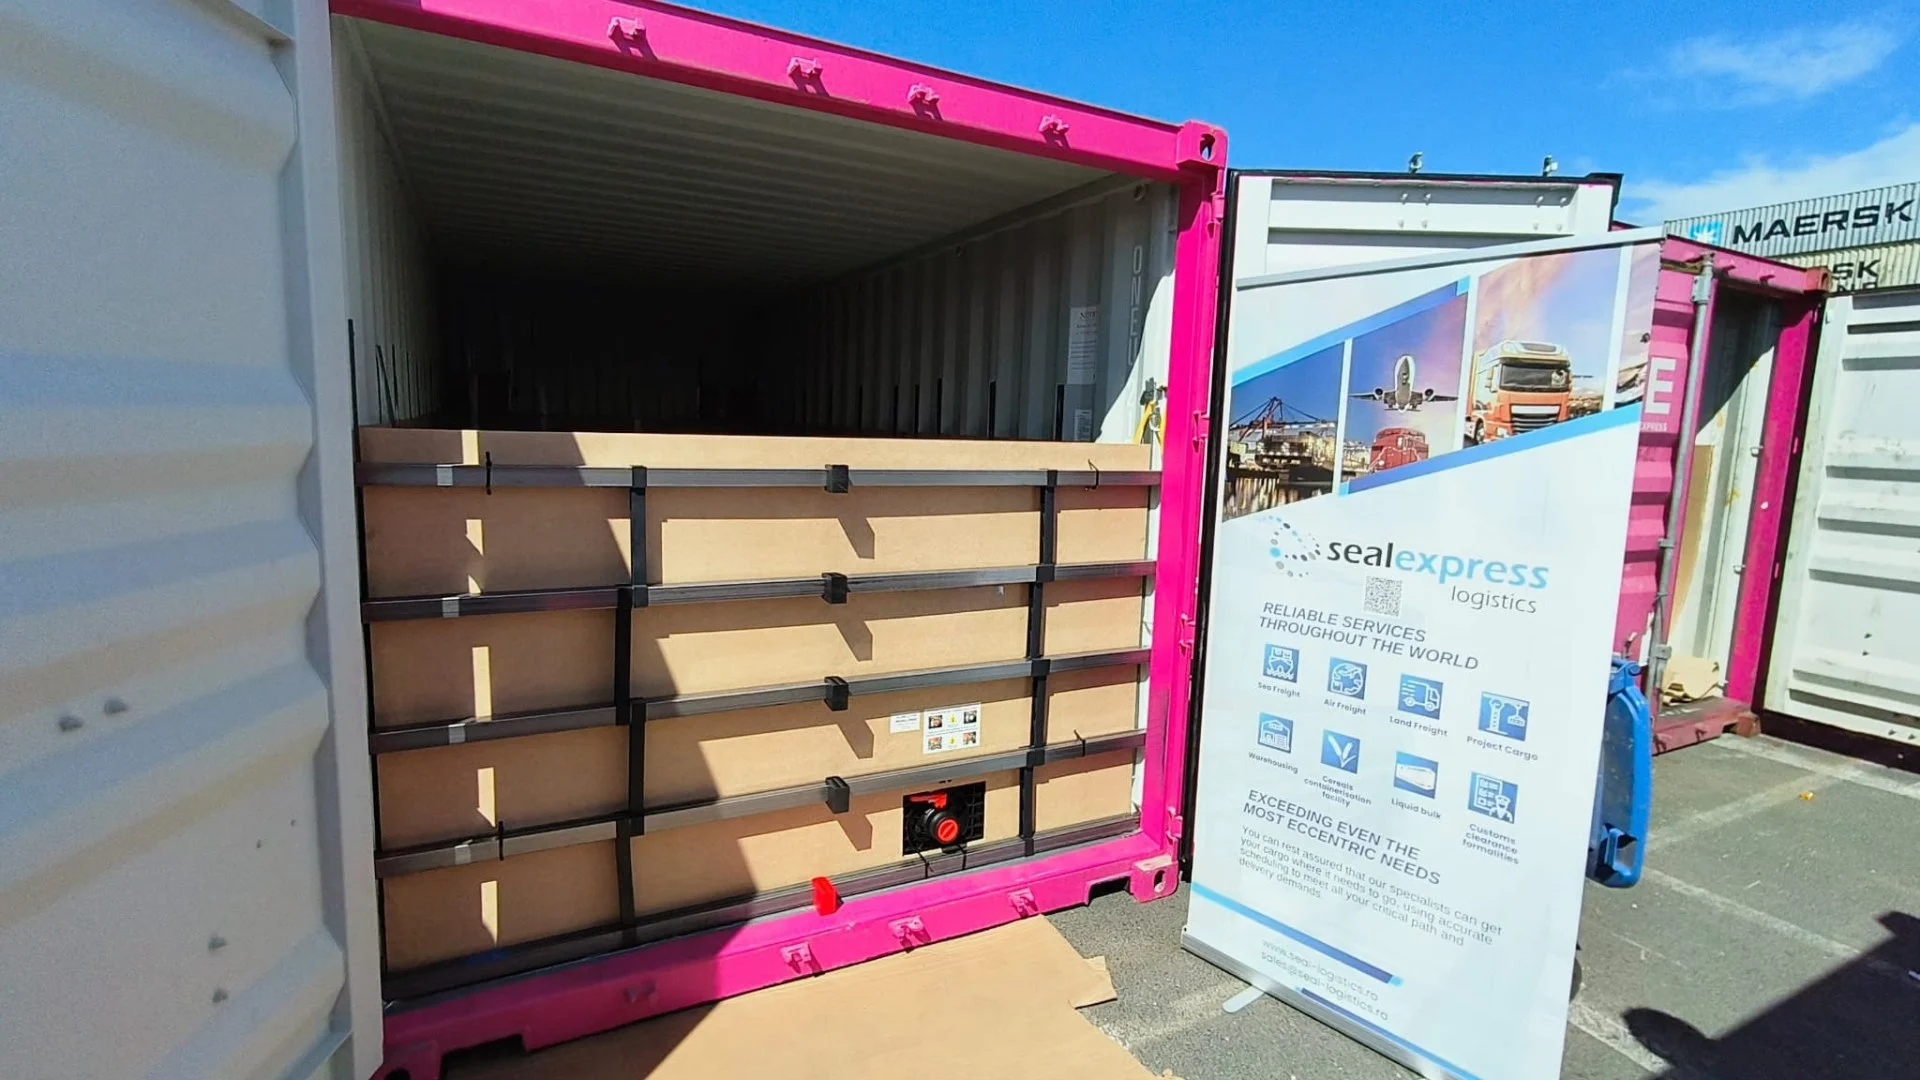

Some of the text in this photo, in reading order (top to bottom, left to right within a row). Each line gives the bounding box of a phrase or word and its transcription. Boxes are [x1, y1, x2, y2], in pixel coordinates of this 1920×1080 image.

[1732, 199, 1915, 245] MAERSK
[1450, 585, 1538, 614] logistics
[1262, 601, 1427, 643] RELIABLE SERVICES
[1259, 615, 1479, 671] THROUGHOUT THE WORLD
[1257, 681, 1301, 699] Sea Freight
[1323, 698, 1367, 716] Air Freight
[1388, 715, 1449, 738] Land Freight
[1466, 734, 1539, 762] Project Cargo
[1248, 751, 1299, 775] Warehousing
[1304, 777, 1372, 806] containerisation
[1322, 775, 1354, 792] Cereals
[1321, 790, 1351, 808] facility
[1390, 796, 1442, 819] Liquid bulk
[1248, 789, 1421, 861] EXCEEDING EVEN THE
[1468, 822, 1517, 846] Customs
[1243, 802, 1441, 886] MOST ECCENTRIC NEEDS
[1462, 838, 1520, 866] formalities
[1465, 831, 1519, 855] clearance
[1238, 857, 1275, 880] delivery
[1241, 824, 1503, 937] You can rest assured that our specialists can get
[1239, 847, 1464, 947] scheduling to meet all your critical path and
[1240, 836, 1262, 851] your
[1263, 844, 1290, 863] cargo
[1291, 857, 1322, 876] where
[1324, 869, 1332, 880] it
[1333, 873, 1367, 894] needs
[1368, 887, 1380, 900] to
[1403, 903, 1435, 924] using
[1438, 916, 1493, 946] accurate
